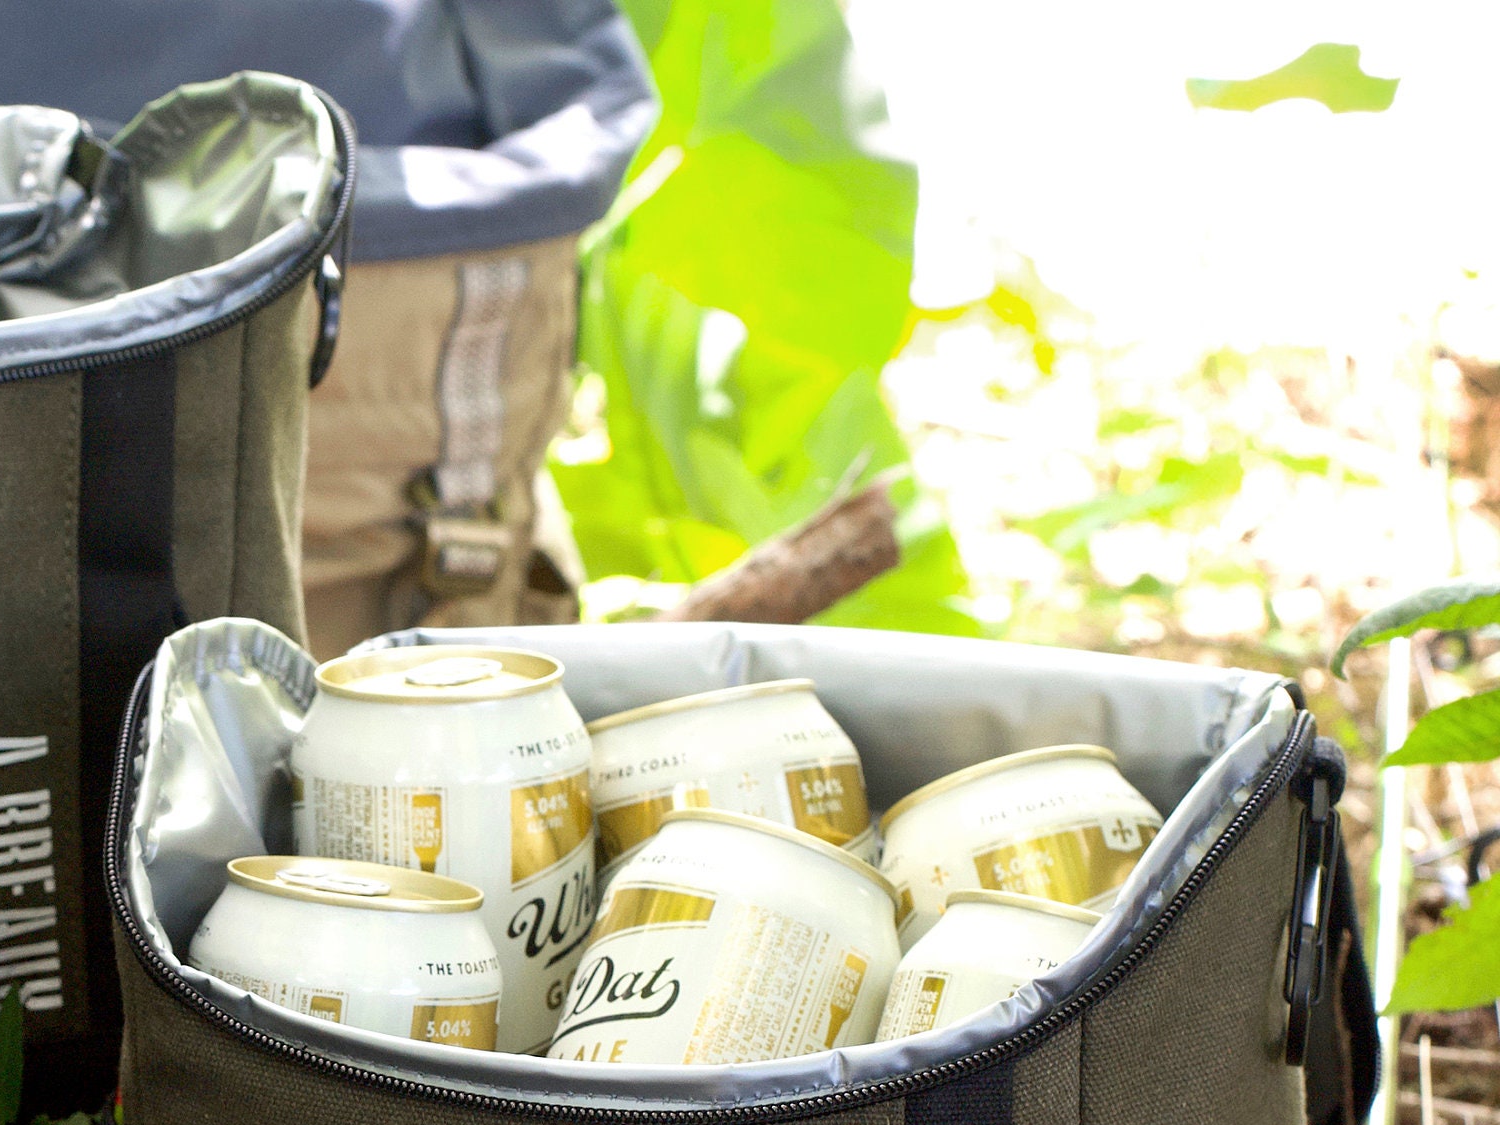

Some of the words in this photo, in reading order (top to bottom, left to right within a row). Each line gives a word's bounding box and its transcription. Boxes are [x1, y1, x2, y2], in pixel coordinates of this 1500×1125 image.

[517, 742, 543, 757] THE
[801, 778, 844, 801] 5.04%
[524, 793, 568, 818] 5.04%
[507, 865, 592, 958] Wh
[427, 963, 453, 976] THE
[457, 960, 489, 976] TOAST
[562, 955, 680, 1024] Dat
[426, 1020, 473, 1038] 5.04%
